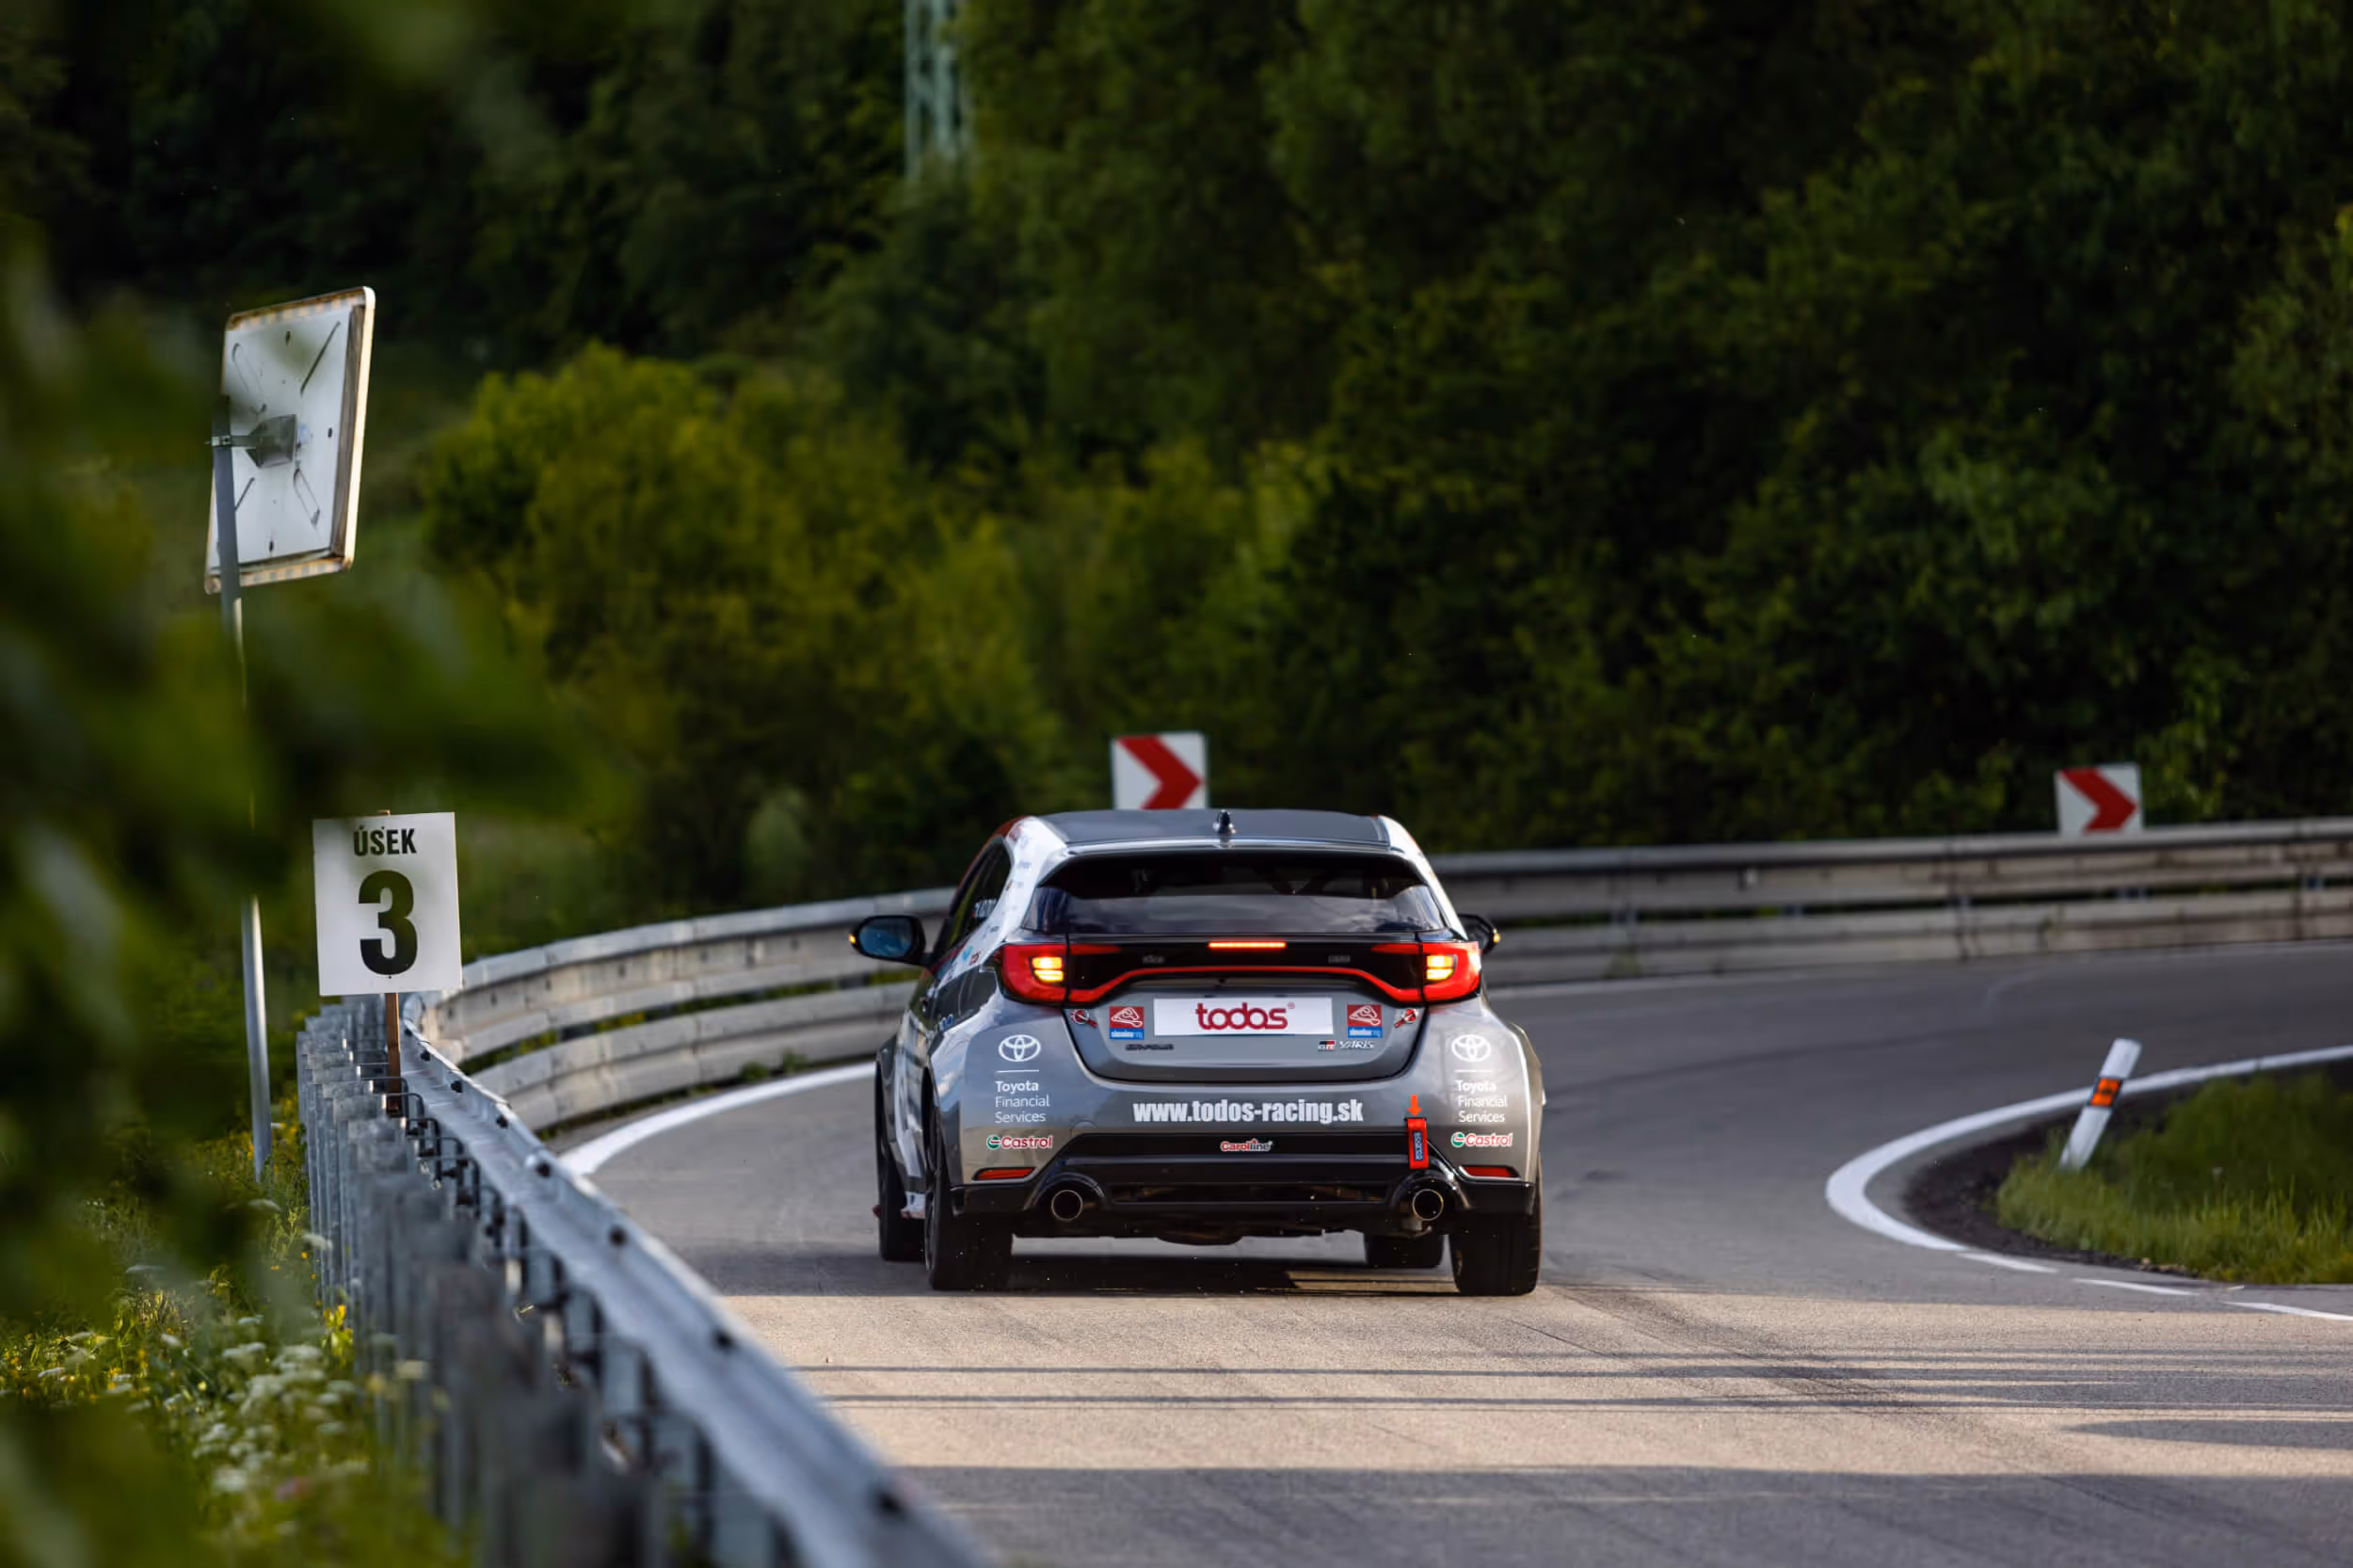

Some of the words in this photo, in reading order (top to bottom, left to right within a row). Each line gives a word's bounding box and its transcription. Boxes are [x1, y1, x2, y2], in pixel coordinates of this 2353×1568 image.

[353, 824, 417, 856] ÚSEK
[359, 870, 418, 976] 3
[1195, 1002, 1289, 1031] todos
[995, 1080, 1039, 1095] Toyota
[1454, 1080, 1497, 1095] Toyota
[995, 1094, 1050, 1108] Financial
[1457, 1095, 1508, 1108] Financial
[994, 1111, 1047, 1124] Services
[1132, 1098, 1364, 1125] www.todos-racing.sk
[1458, 1110, 1505, 1123] Services
[1000, 1135, 1053, 1149] Castrol
[1465, 1132, 1513, 1147] Castrol
